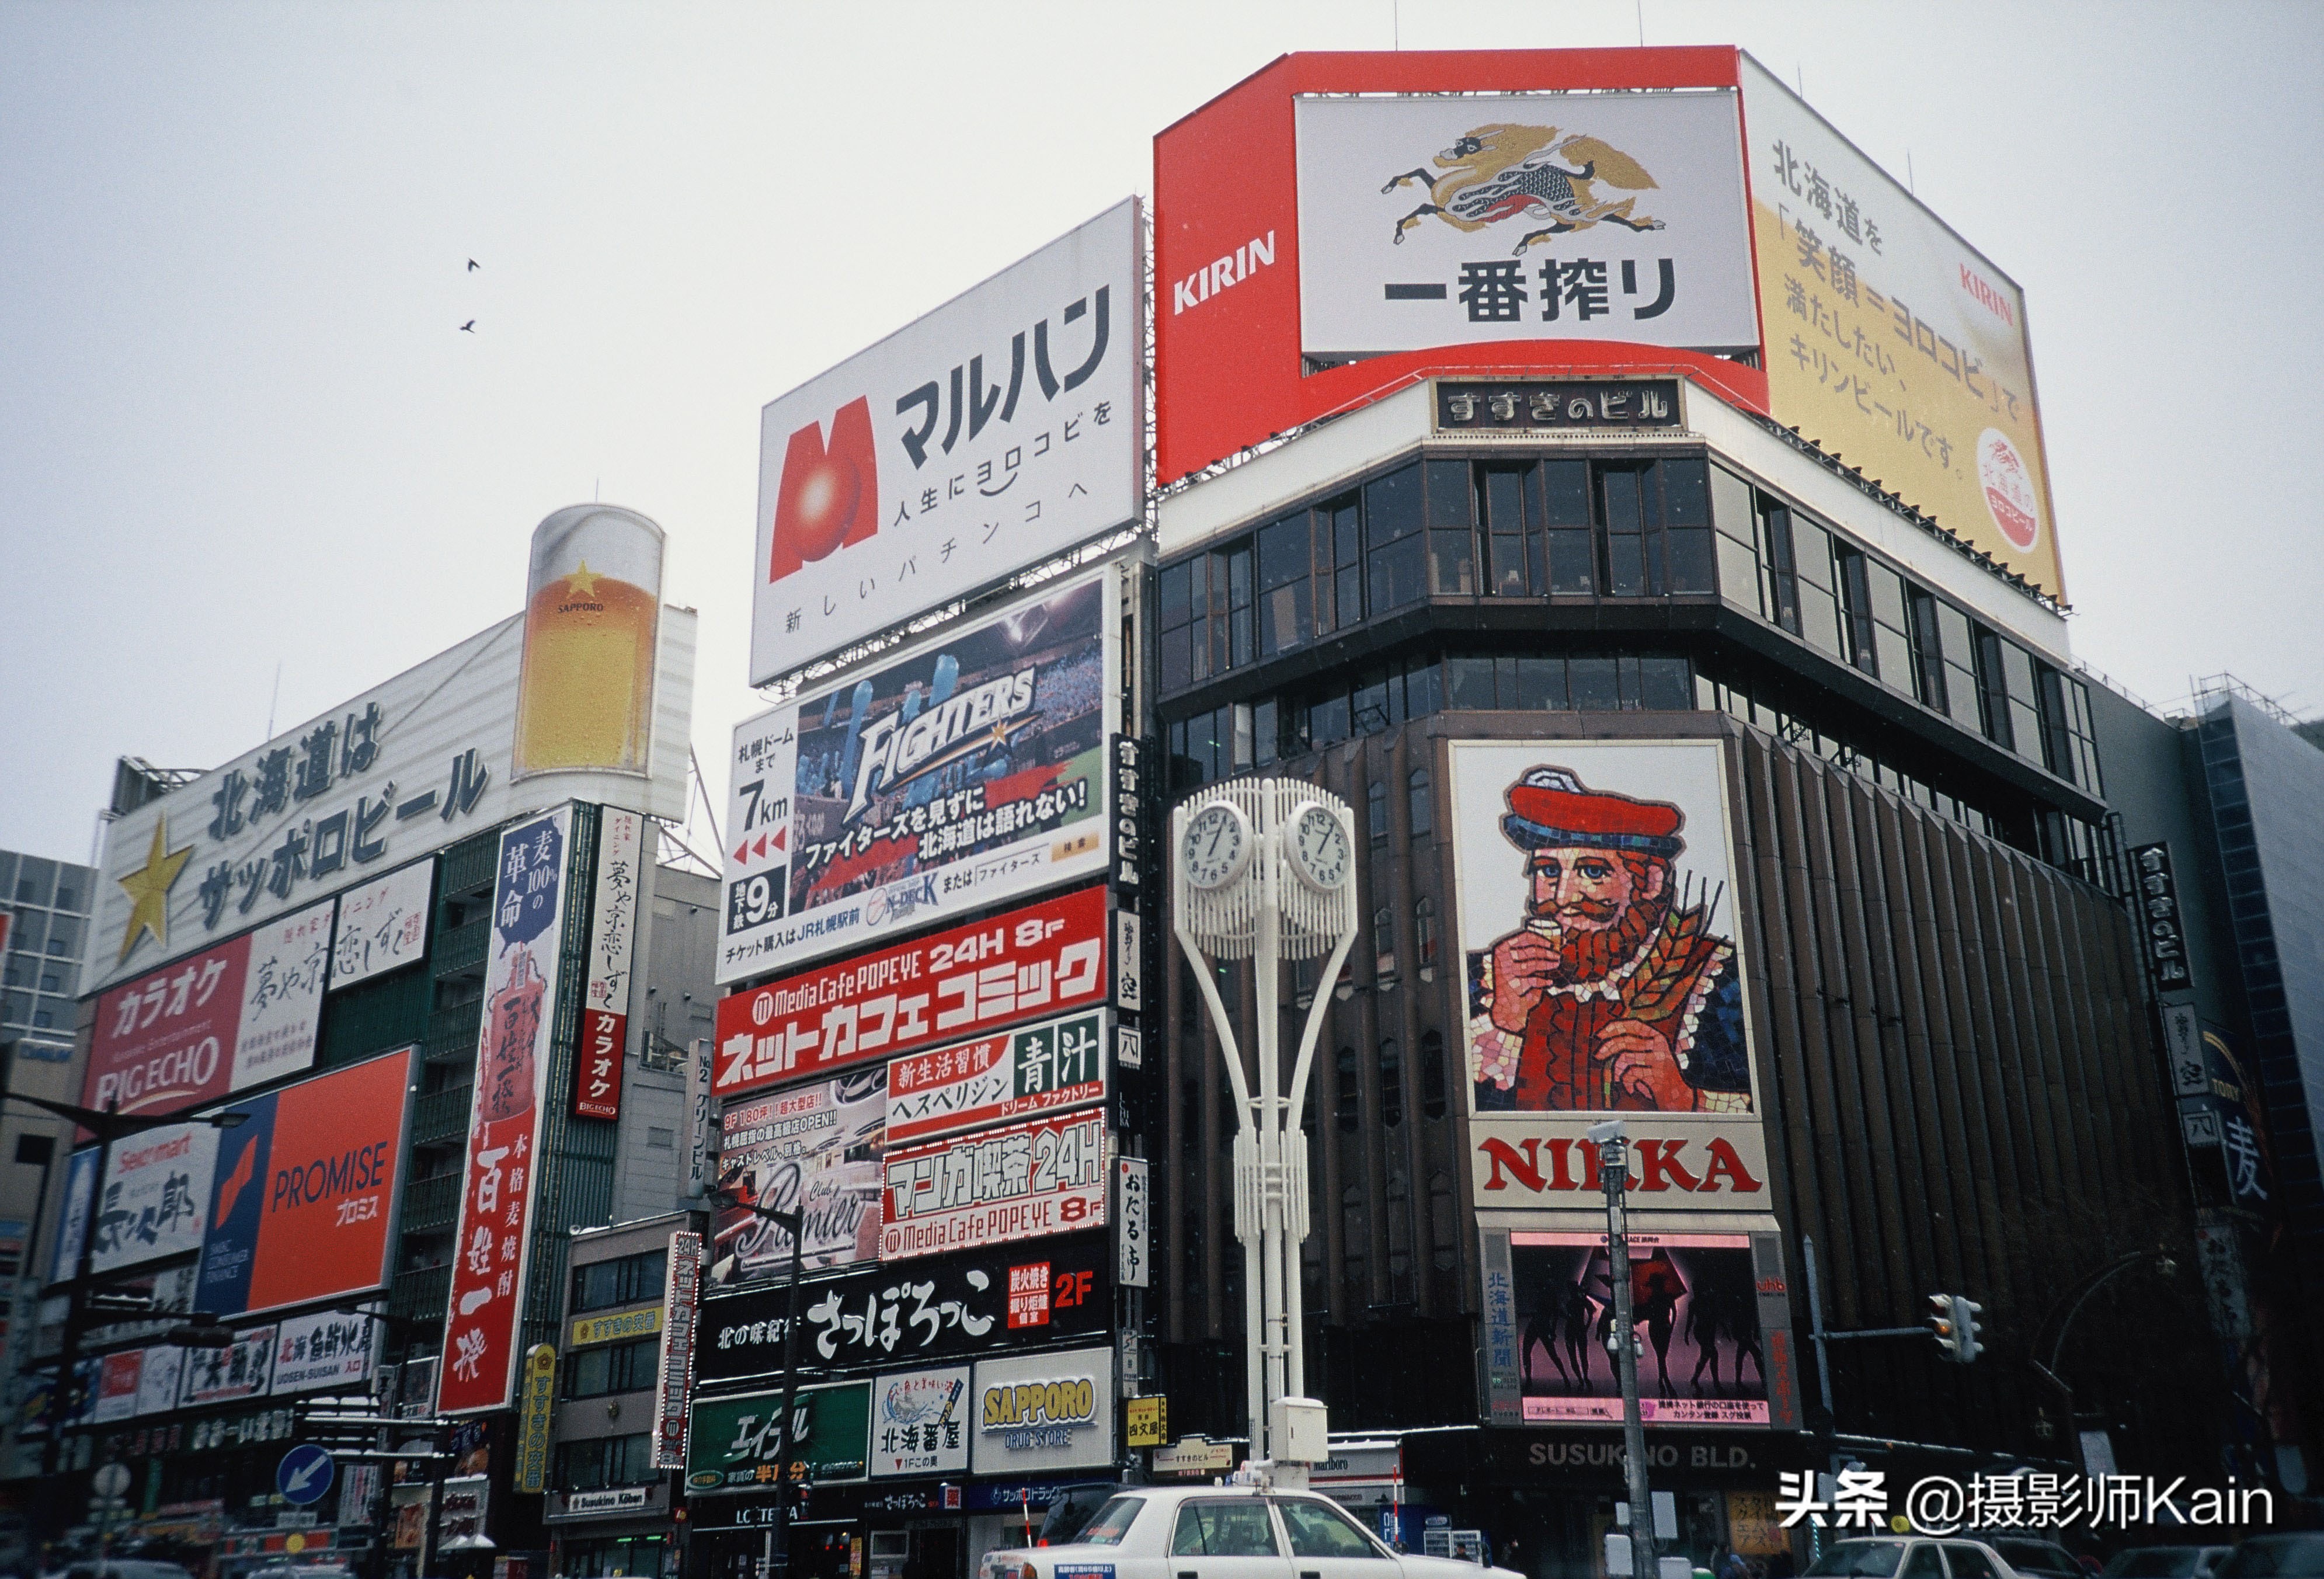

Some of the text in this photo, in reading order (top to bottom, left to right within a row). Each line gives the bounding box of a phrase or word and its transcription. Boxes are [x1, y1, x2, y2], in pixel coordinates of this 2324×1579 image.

[1773, 139, 1882, 256] 北海道を
[1173, 229, 1276, 316] KIRIN
[1383, 257, 1676, 323] 一番搾り
[1960, 262, 2013, 327] KIRIN
[896, 284, 1110, 470] マルハン
[1448, 389, 1668, 422] すすきのビル
[1790, 333, 1963, 480] キリンビールです。
[894, 401, 1112, 527] 人生にヨロコビを
[785, 482, 1088, 634] 新しいパチンコへ
[557, 602, 604, 614] SAPPORO
[208, 702, 385, 841] 北海道は
[738, 726, 794, 764] 札幌ドーム
[754, 754, 775, 774] まで
[843, 667, 1036, 824] FIGHTERS
[739, 779, 788, 833] 7km
[805, 786, 986, 870] ファイターズを見ずに
[200, 748, 490, 931] サッポロビール
[500, 843, 530, 929] 革命
[733, 874, 780, 930] 地下鉄 9分
[943, 870, 973, 895] または
[774, 918, 1066, 1018] Media Cafe POPEYE 24H 8F
[113, 959, 227, 1039] カラオケ
[717, 937, 1101, 1089] ネットカフェコミック
[589, 1015, 617, 1098] カラオケ
[899, 1042, 992, 1088] 新生活習慣
[1017, 1026, 1099, 1094] 青汁
[723, 1112, 737, 1131] 9F
[892, 1076, 1009, 1121] ヘスペリジン
[1001, 1084, 1100, 1117] ドリーム ファクトリー
[272, 1141, 388, 1213] PROMISE
[886, 1119, 1101, 1222] マンガ喫茶 24H
[336, 1195, 379, 1227] プロミス
[496, 1133, 528, 1298] 本格麦焼酎
[903, 1195, 1101, 1252] Media Cafe POPEYE 8F
[677, 1236, 699, 1257] 24H
[1011, 1266, 1049, 1293] 炭火焼き
[1055, 1271, 1094, 1308] 2F
[593, 1312, 657, 1338] すすきの交番
[808, 1270, 996, 1359] さっぽろっこ
[1489, 1272, 1512, 1367] 北海道新聞
[526, 1374, 552, 1488] すすきの交番
[983, 1378, 1094, 1426] SAPPORO
[1129, 1421, 1158, 1437] 四文屋
[881, 1421, 960, 1453] 北海番屋
[904, 1455, 938, 1468] 1Fこの奥
[1004, 1428, 1073, 1449] DRUG STORE
[1529, 1443, 1756, 1470] SUSUKNO BLD.
[581, 1493, 615, 1509] Susukino
